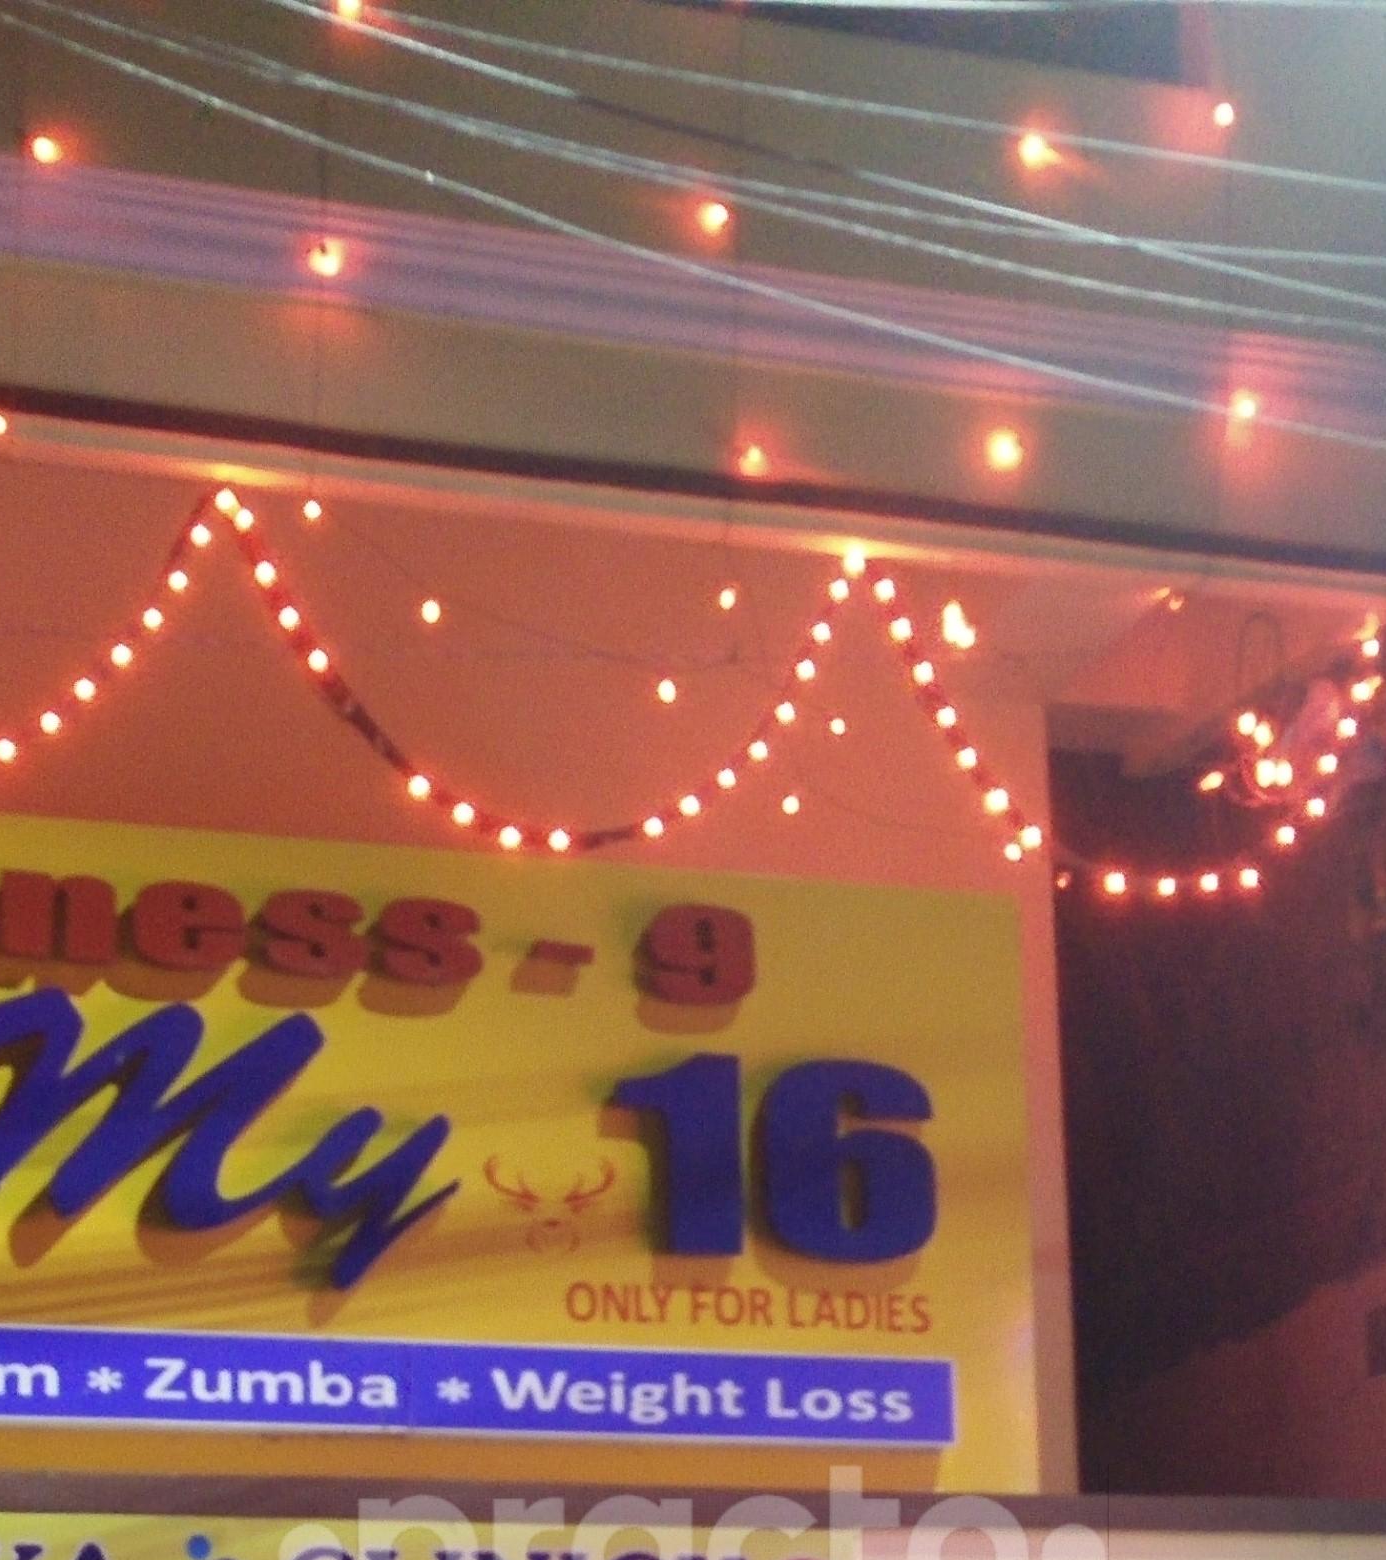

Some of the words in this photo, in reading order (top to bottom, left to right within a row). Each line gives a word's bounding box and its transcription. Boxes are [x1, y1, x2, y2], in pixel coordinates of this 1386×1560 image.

[635, 903, 757, 1007] 9
[615, 1052, 938, 1264] 16
[565, 1282, 671, 1324] ONLY
[688, 1284, 774, 1328] FOR
[786, 1290, 932, 1334] LADIES
[143, 1357, 399, 1408] Zumba
[491, 1368, 746, 1424] Weight
[765, 1378, 913, 1423] Loss
